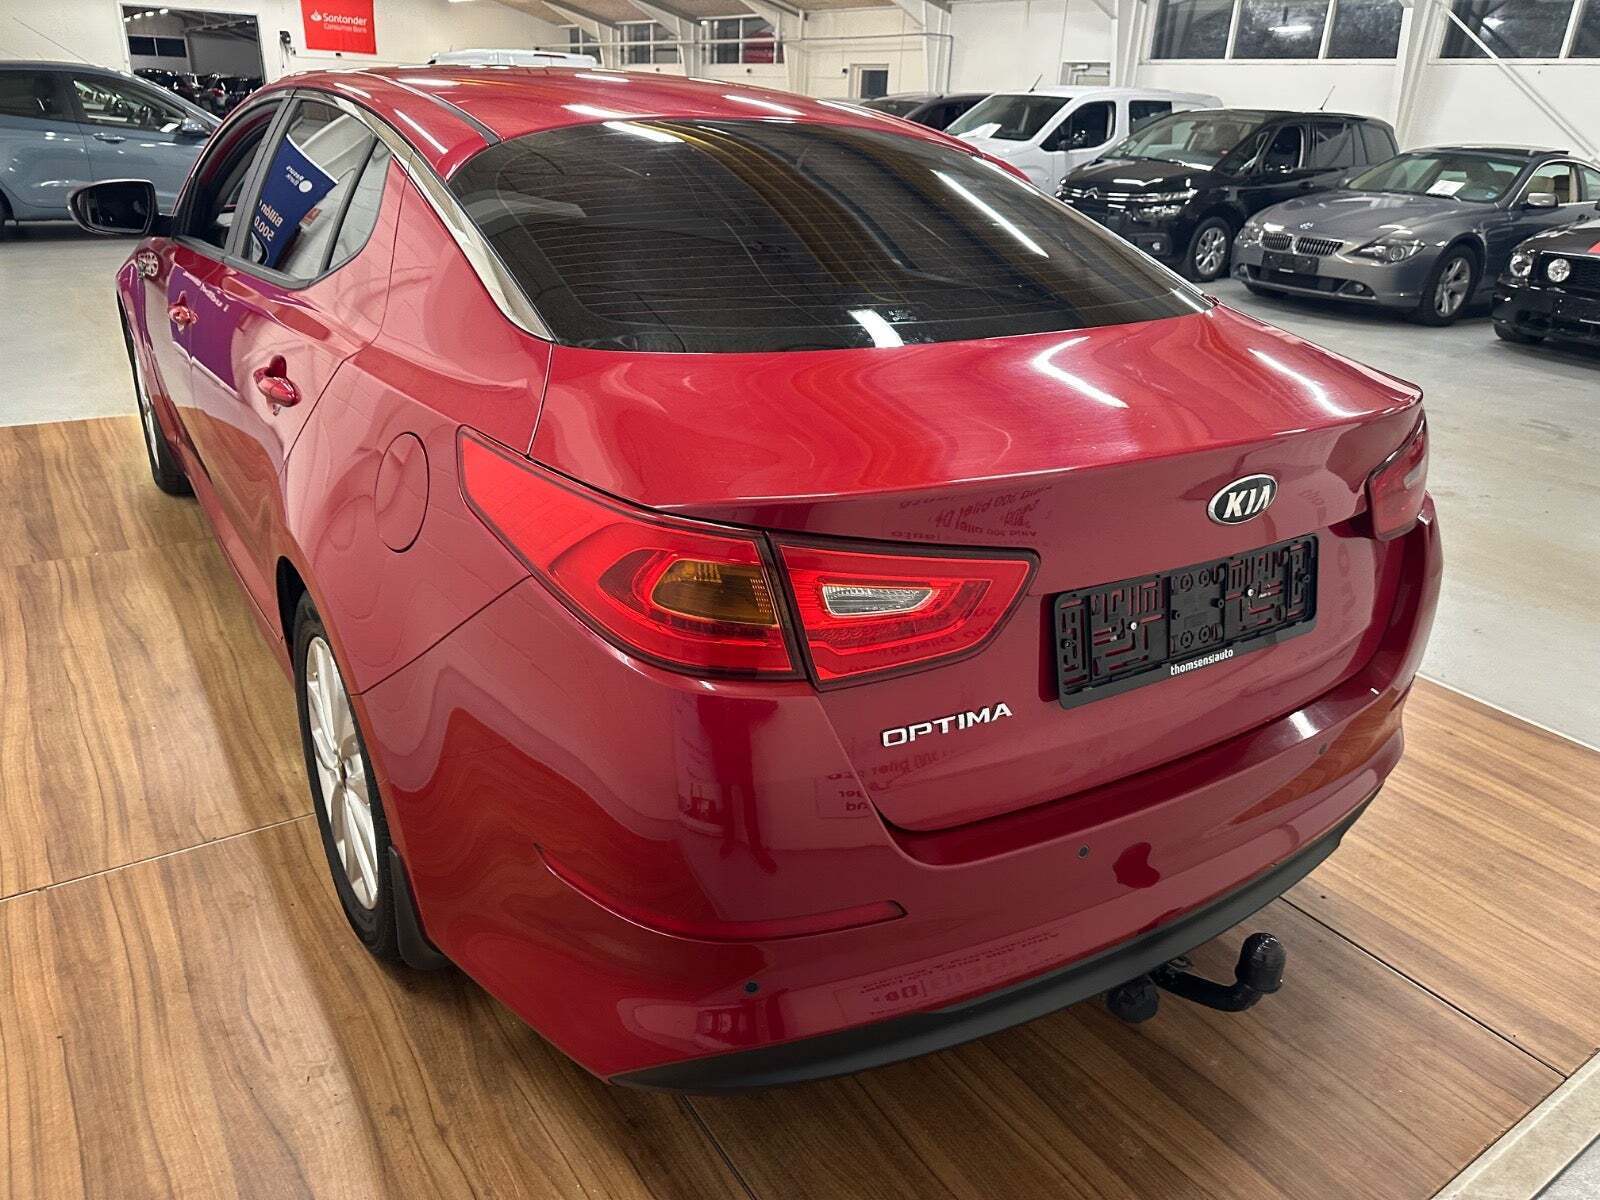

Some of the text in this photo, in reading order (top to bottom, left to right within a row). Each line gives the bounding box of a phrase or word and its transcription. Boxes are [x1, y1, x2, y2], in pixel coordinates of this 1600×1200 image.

[323, 13, 367, 25] Santander
[1222, 484, 1271, 519] KIA
[881, 702, 1013, 748] OPTIMA
